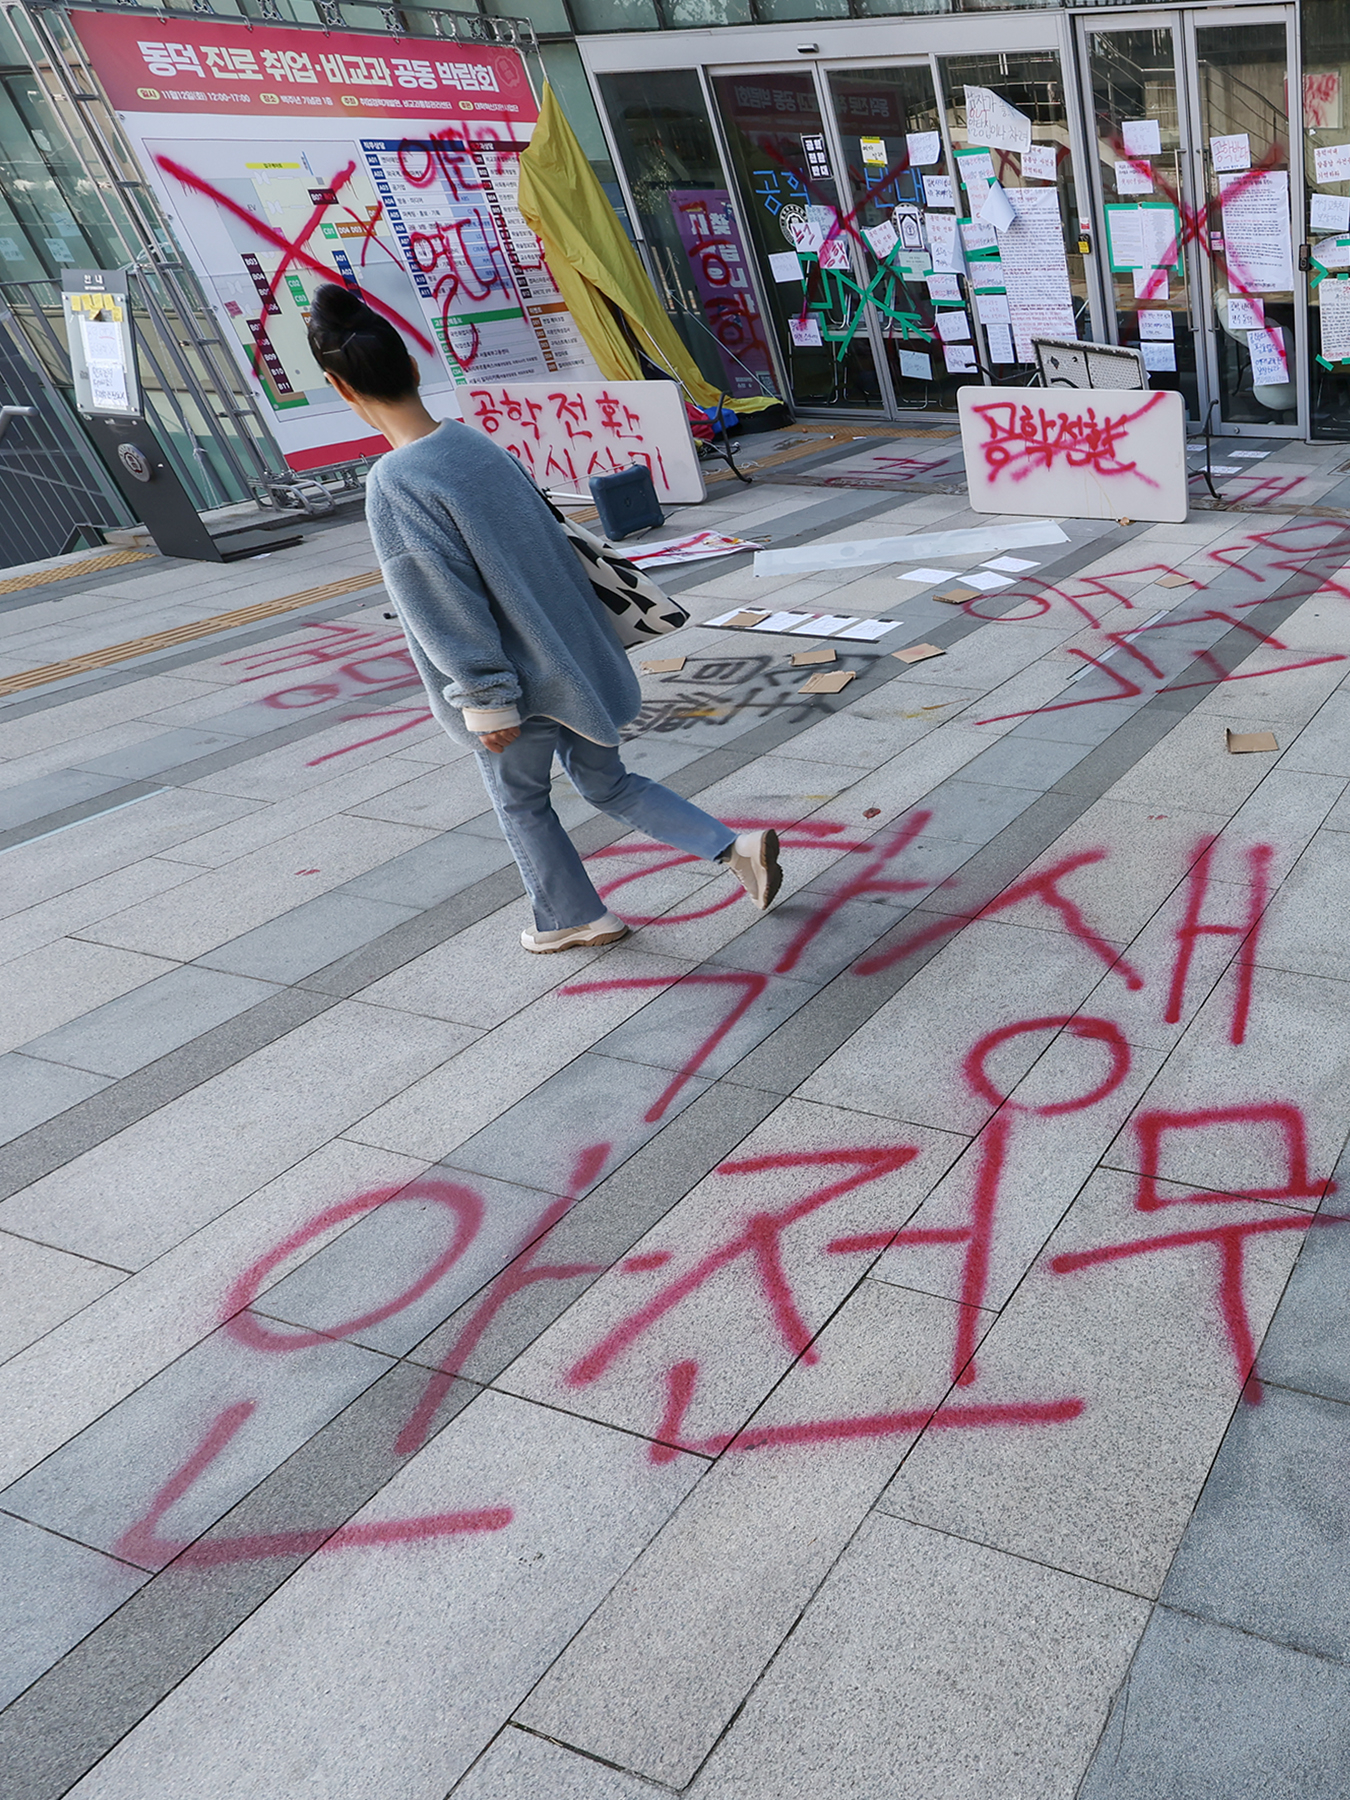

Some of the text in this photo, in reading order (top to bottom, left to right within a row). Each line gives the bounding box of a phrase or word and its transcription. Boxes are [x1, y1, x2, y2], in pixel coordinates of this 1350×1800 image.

[137, 41, 206, 78] 동덕
[199, 46, 264, 80] 진로
[390, 58, 438, 90] 공동
[435, 61, 500, 92] 박람회
[207, 92, 251, 104] 12:00-17:00
[262, 95, 277, 103] 장소
[280, 95, 302, 105] 백주년
[970, 108, 991, 126] OUT
